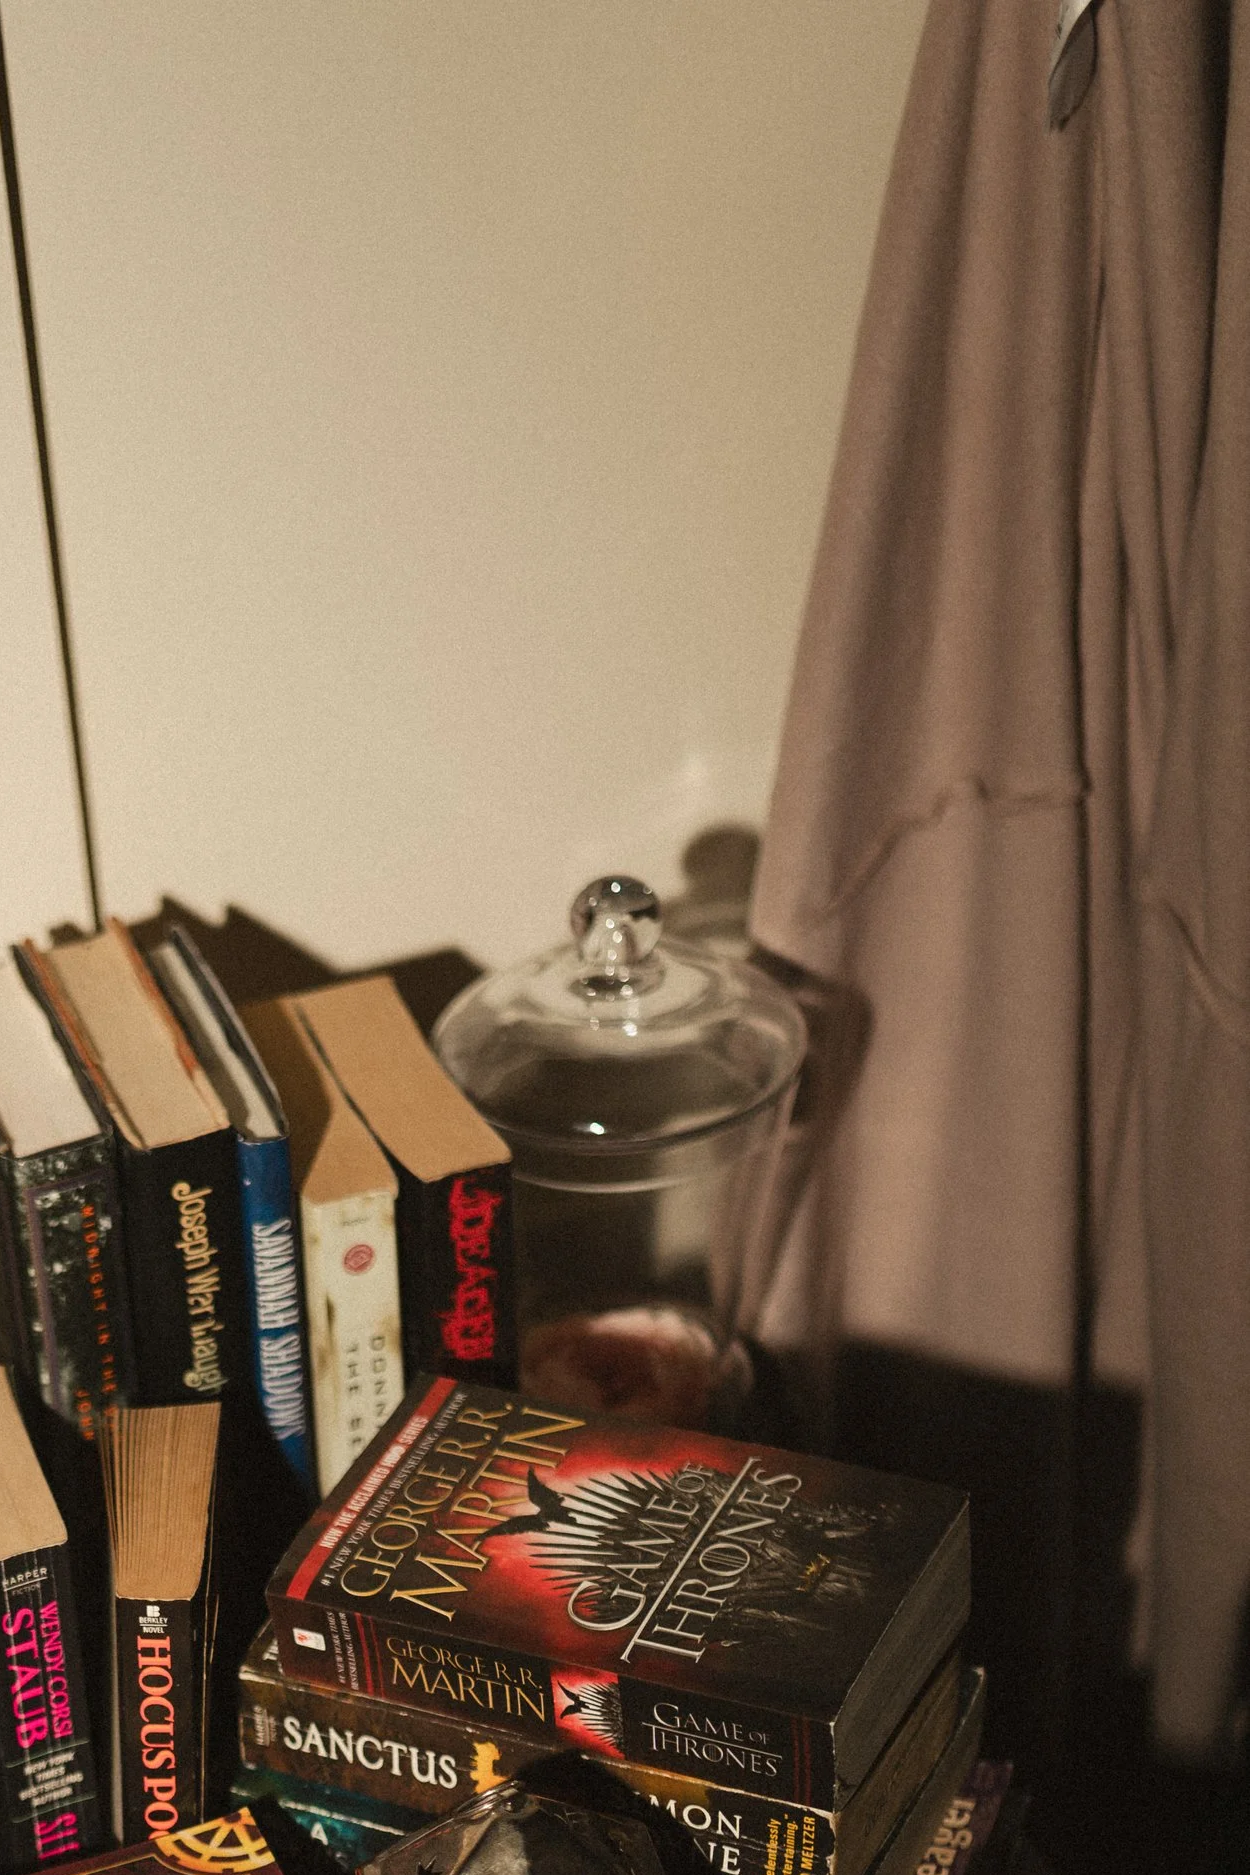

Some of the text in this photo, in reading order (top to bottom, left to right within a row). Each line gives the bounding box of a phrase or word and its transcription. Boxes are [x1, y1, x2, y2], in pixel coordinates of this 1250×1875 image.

[171, 1180, 218, 1270] Joseph
[252, 1219, 300, 1329] SAVANNAH
[317, 1412, 428, 1551] NOW THE ACCLAIMED HBO SERIES
[329, 1389, 468, 1573] NEW YORK TIMES BESTSELLING AUTHOR
[340, 1466, 467, 1597] GEORGE
[390, 1407, 586, 1621] MARTIN
[568, 1462, 715, 1631] GAME OF
[3, 1568, 48, 1589] HARPER
[12, 1583, 41, 1595] FICTION
[623, 1462, 801, 1663] THRONES
[139, 1617, 168, 1625] BERKLEY
[143, 1626, 164, 1634] NOVEL
[3, 1607, 49, 1749] STAUB
[39, 1601, 73, 1739] WENDY CORSI
[387, 1637, 490, 1675] GEORGE
[137, 1636, 176, 1770] HOCUS
[391, 1657, 546, 1722] MARTIN
[283, 1716, 458, 1789] SANCTUS
[649, 1724, 780, 1777] THRONES
[653, 1702, 771, 1745] GAME OF
[20, 1773, 84, 1801] BESTSELLING
[36, 1766, 66, 1783] TIMES
[49, 1752, 75, 1769] YORK
[33, 1787, 73, 1806] AUTHOR
[800, 1816, 816, 1862] MELTZER
